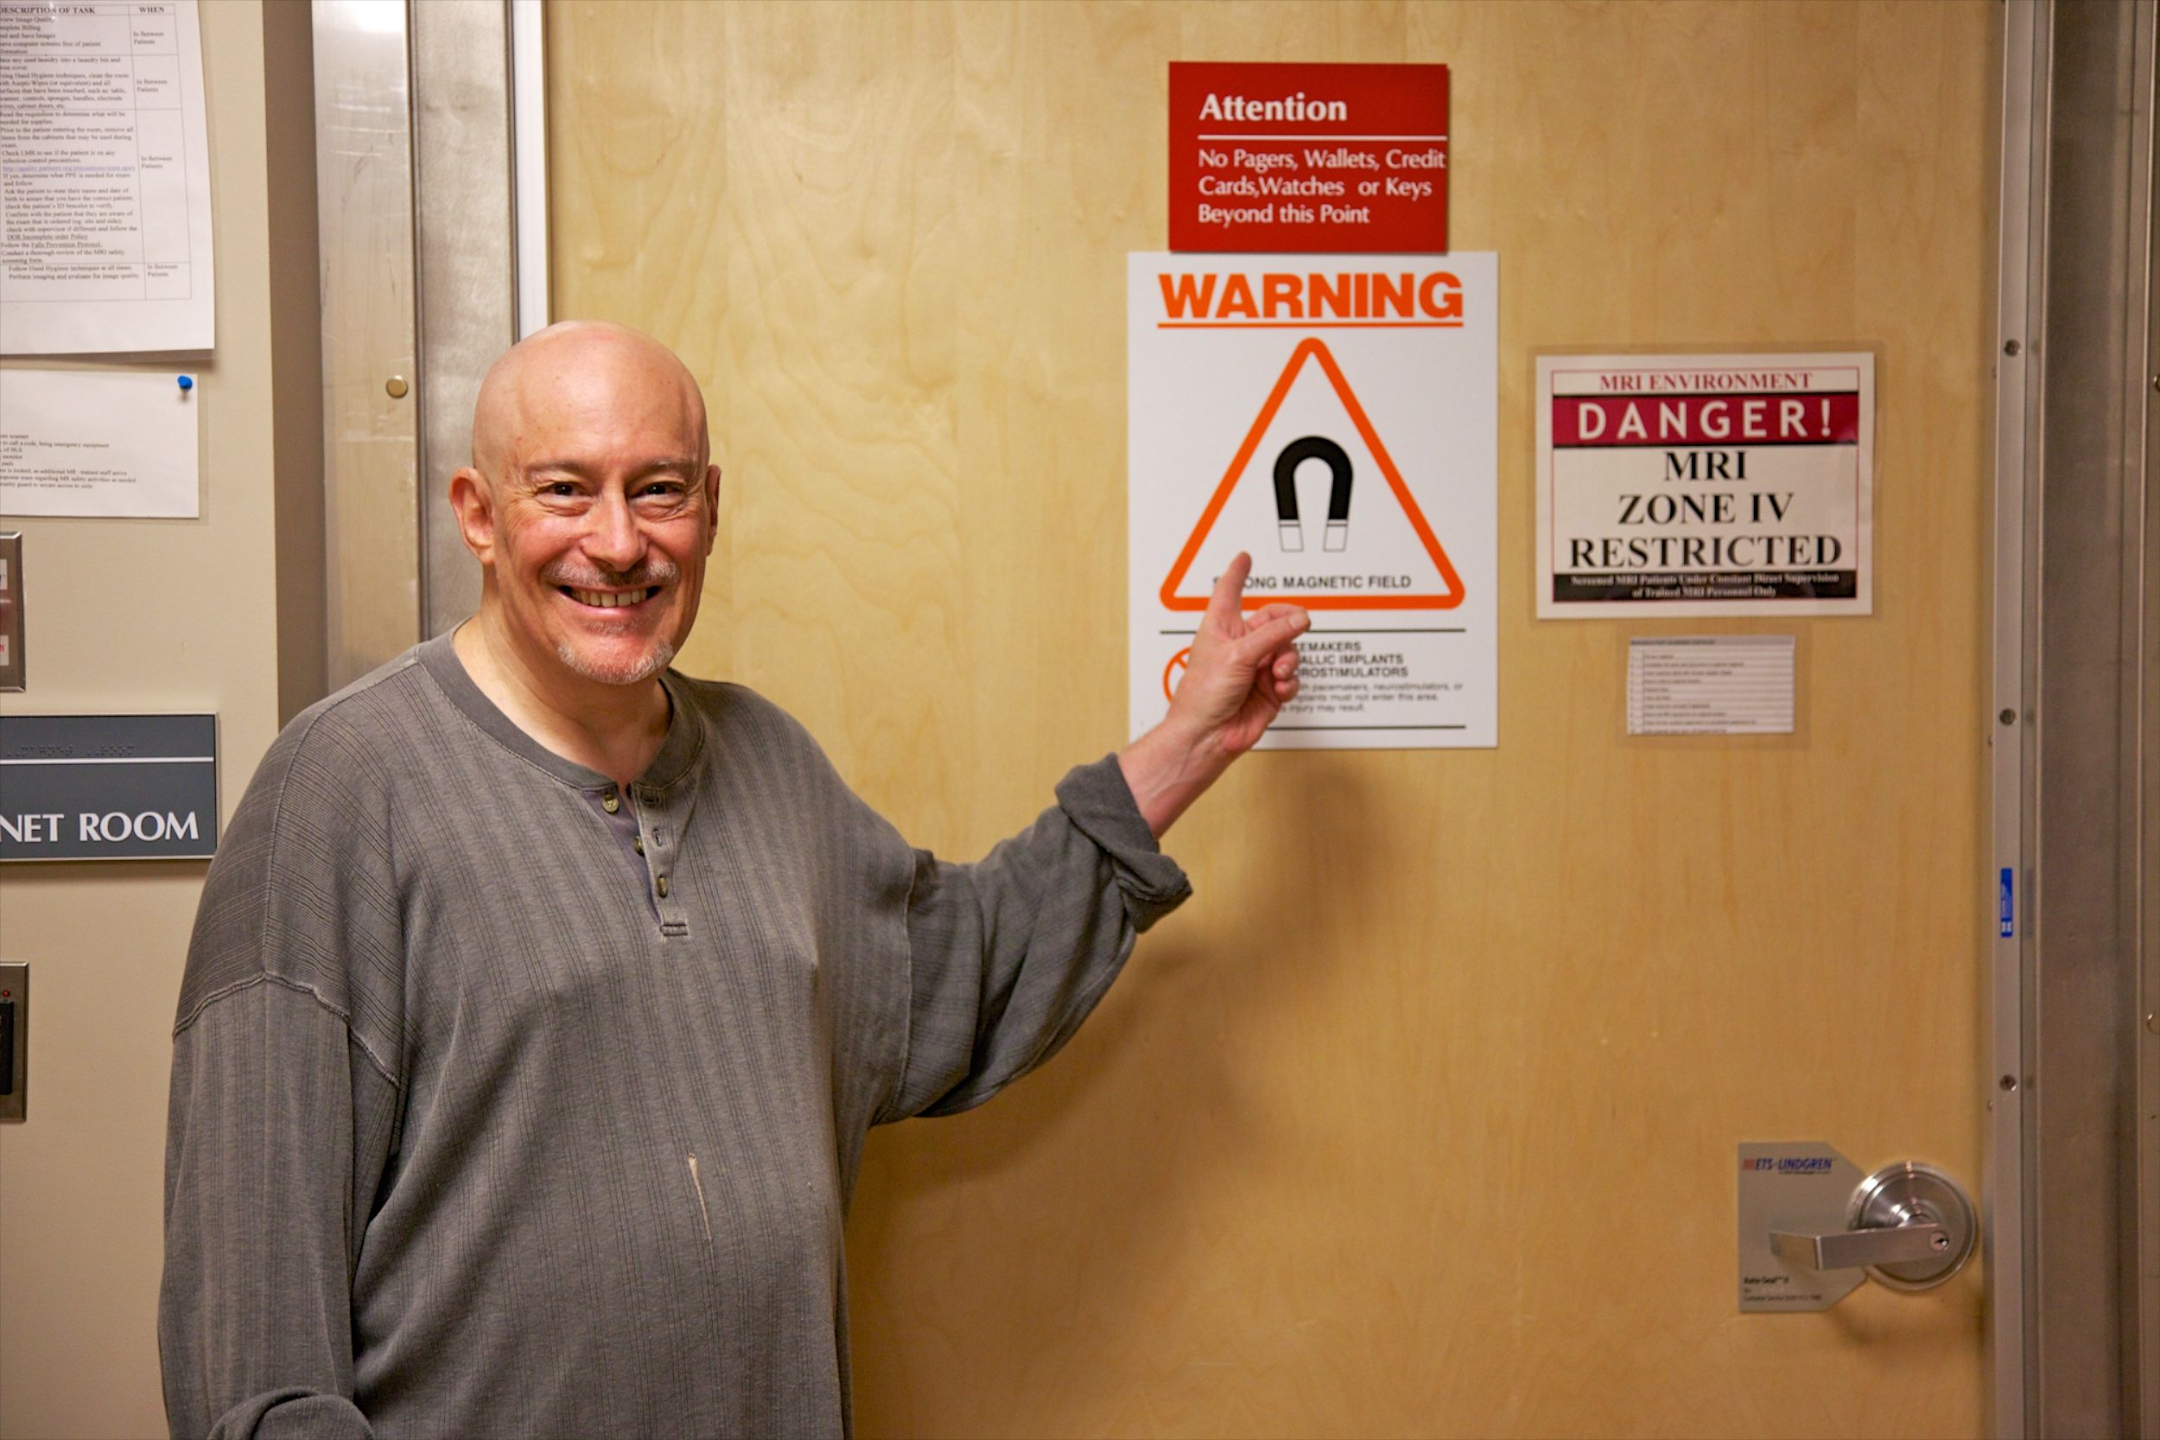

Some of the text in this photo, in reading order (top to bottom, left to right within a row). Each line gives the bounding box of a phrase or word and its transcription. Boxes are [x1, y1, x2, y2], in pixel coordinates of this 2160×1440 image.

[1199, 91, 1348, 121] Attention
[1198, 148, 1446, 174] No Pagers, Wallets, Credit
[1357, 180, 1380, 196] or
[1386, 177, 1432, 202] Keys
[1198, 203, 1370, 228] Beyond this Point
[1158, 272, 1464, 319] WARNING
[1600, 372, 1813, 391] MRI ENVIRONMENT
[1578, 399, 1832, 440] DANGER!
[1664, 450, 1748, 481] MRI
[1618, 492, 1794, 525] ZONE IV
[1569, 535, 1842, 568] RESTRICTED
[1283, 575, 1363, 589] MAGNETIC
[1367, 575, 1412, 588] FIELD
[1571, 573, 1839, 586] Screened MRI Patients Under Constant Direct Supervision
[1632, 586, 1776, 598] of Trained MRI Personnel Only
[1298, 642, 1361, 652] EMAKERS
[1299, 654, 1404, 665] ALLIC IMPLANTS
[1295, 667, 1409, 678] ROSTIMULATORS
[1398, 693, 1414, 701] this
[79, 812, 199, 842] ROOM
